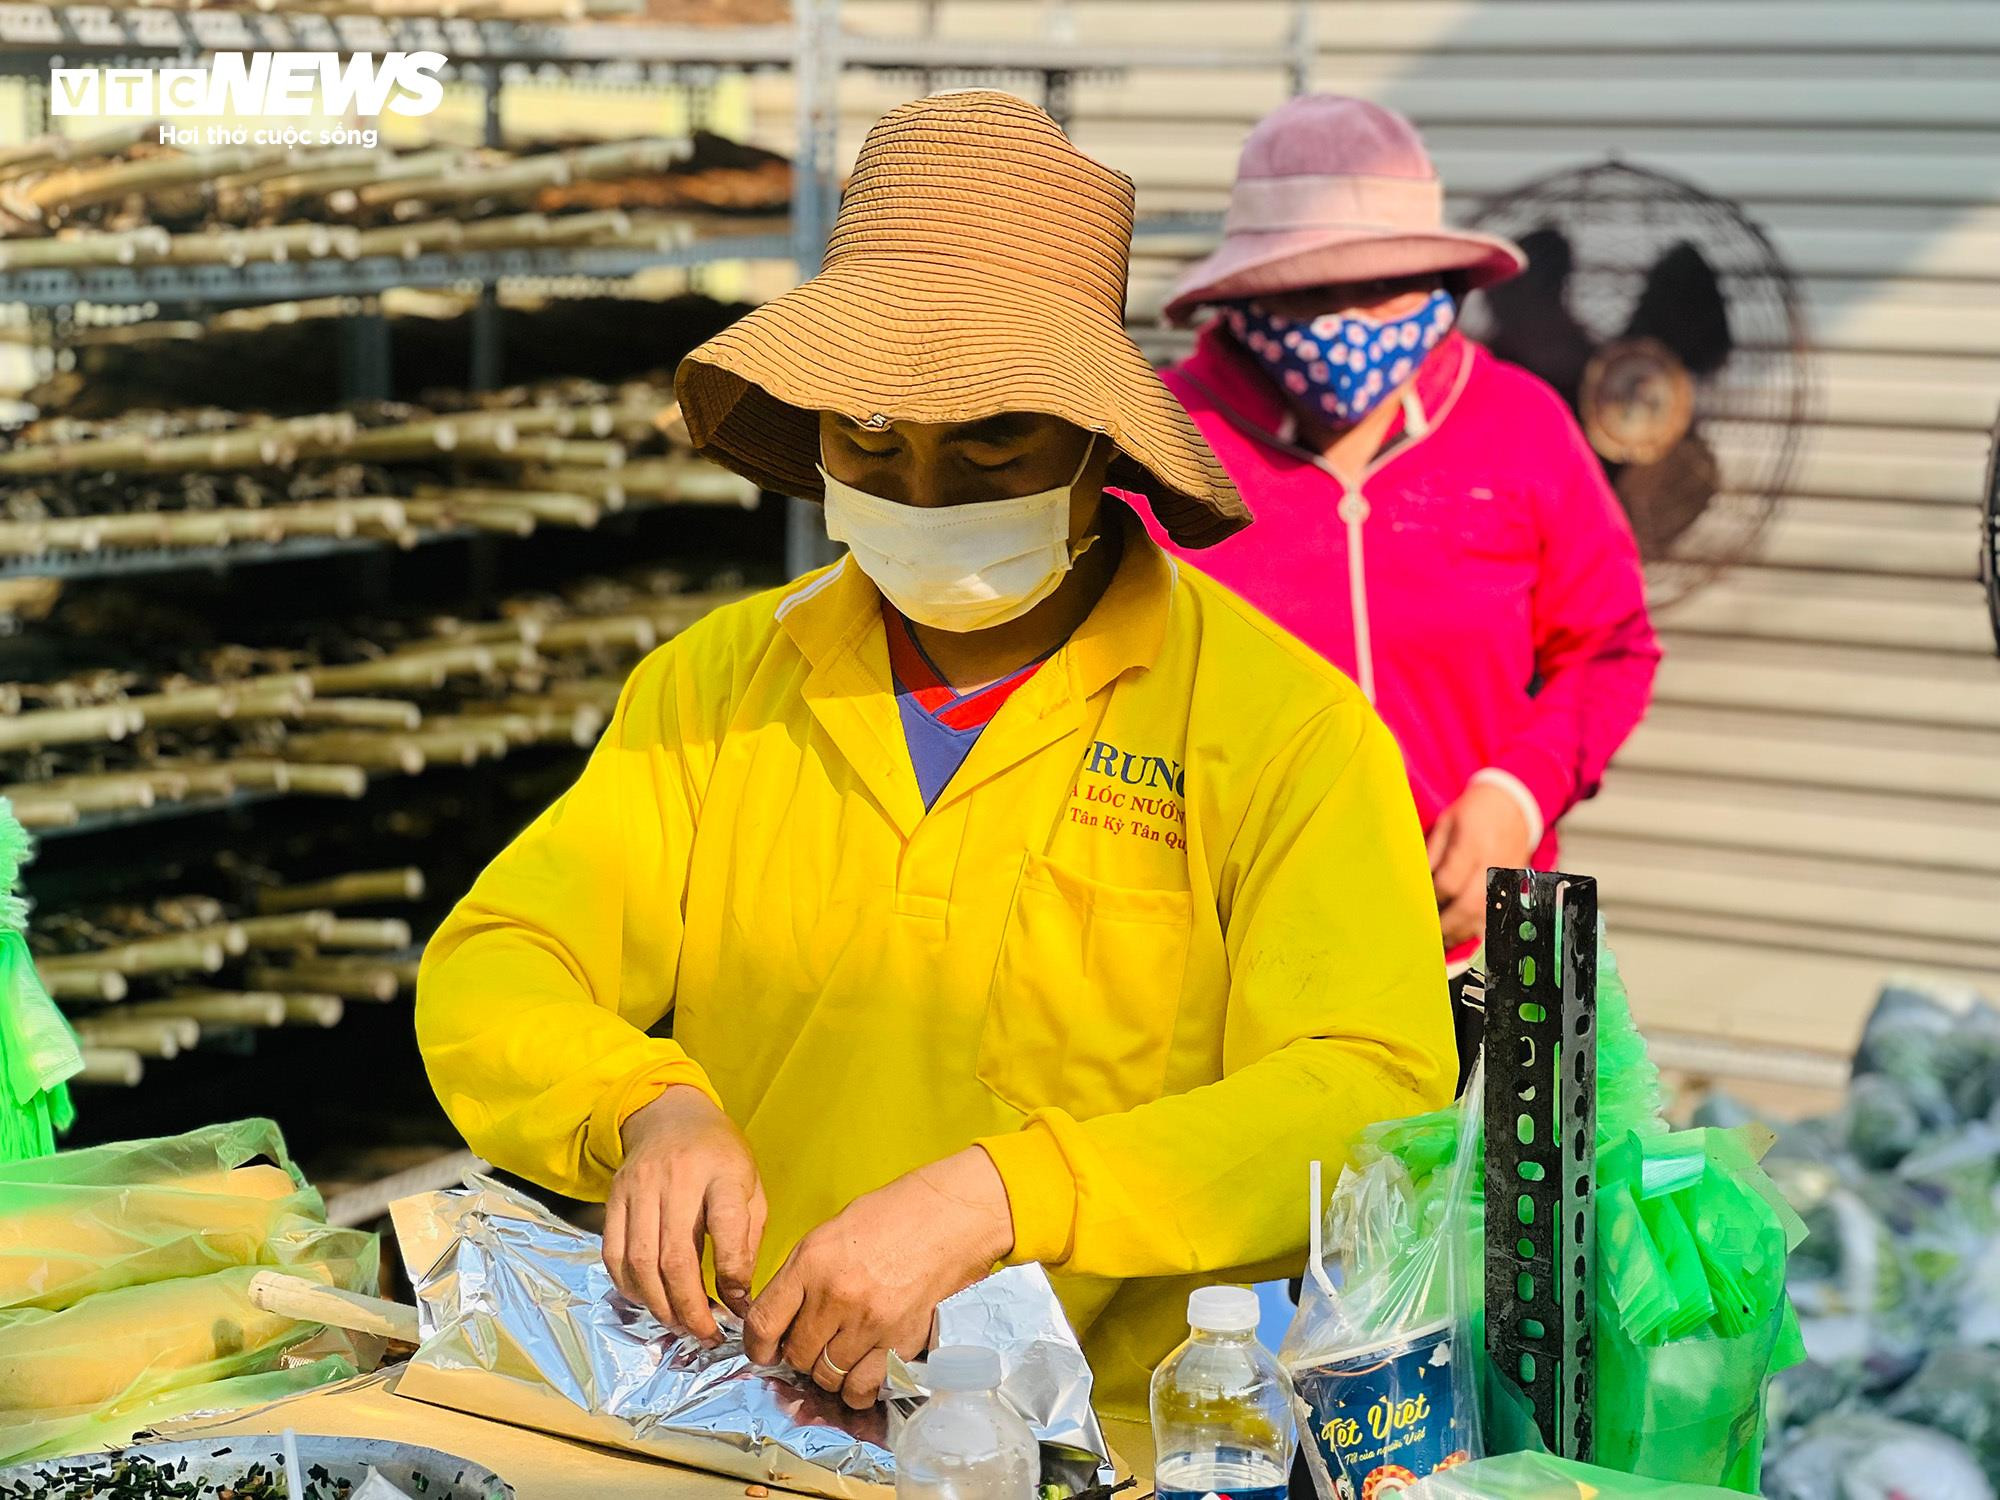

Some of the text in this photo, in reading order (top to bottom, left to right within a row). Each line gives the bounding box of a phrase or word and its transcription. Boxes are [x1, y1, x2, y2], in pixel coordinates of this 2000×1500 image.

[1083, 740, 1185, 799] RUN
[1085, 784, 1126, 808] LÓC
[1070, 807, 1098, 827] Tân
[1130, 821, 1160, 842] Tân
[1321, 1392, 1431, 1452] Tết Việt
